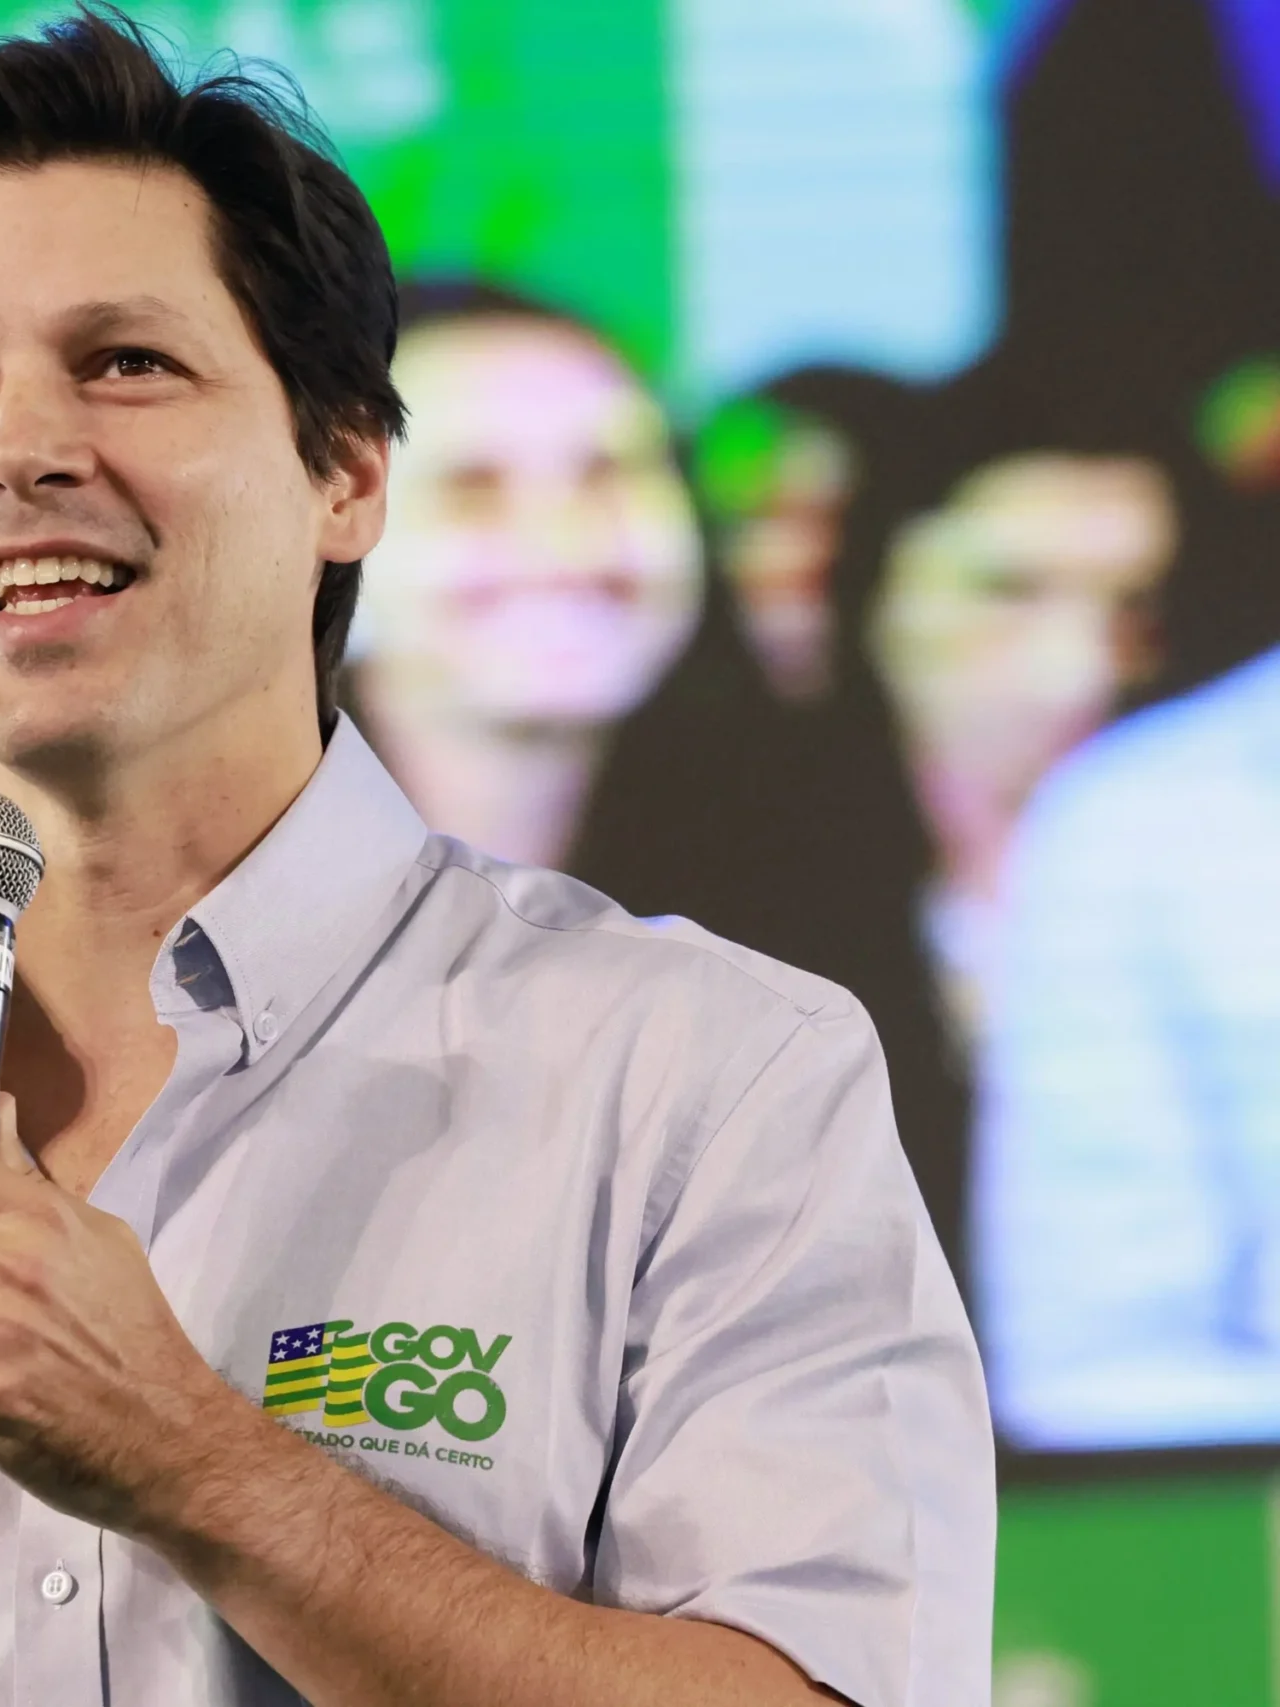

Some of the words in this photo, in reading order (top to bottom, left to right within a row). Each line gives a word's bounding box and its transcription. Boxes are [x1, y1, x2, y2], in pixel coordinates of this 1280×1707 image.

[370, 1321, 513, 1374] GOV
[364, 1362, 507, 1442] GO
[293, 1428, 355, 1448] TADO
[359, 1436, 400, 1454] QUE
[404, 1440, 430, 1459] DÁ
[435, 1447, 494, 1471] CERTO
